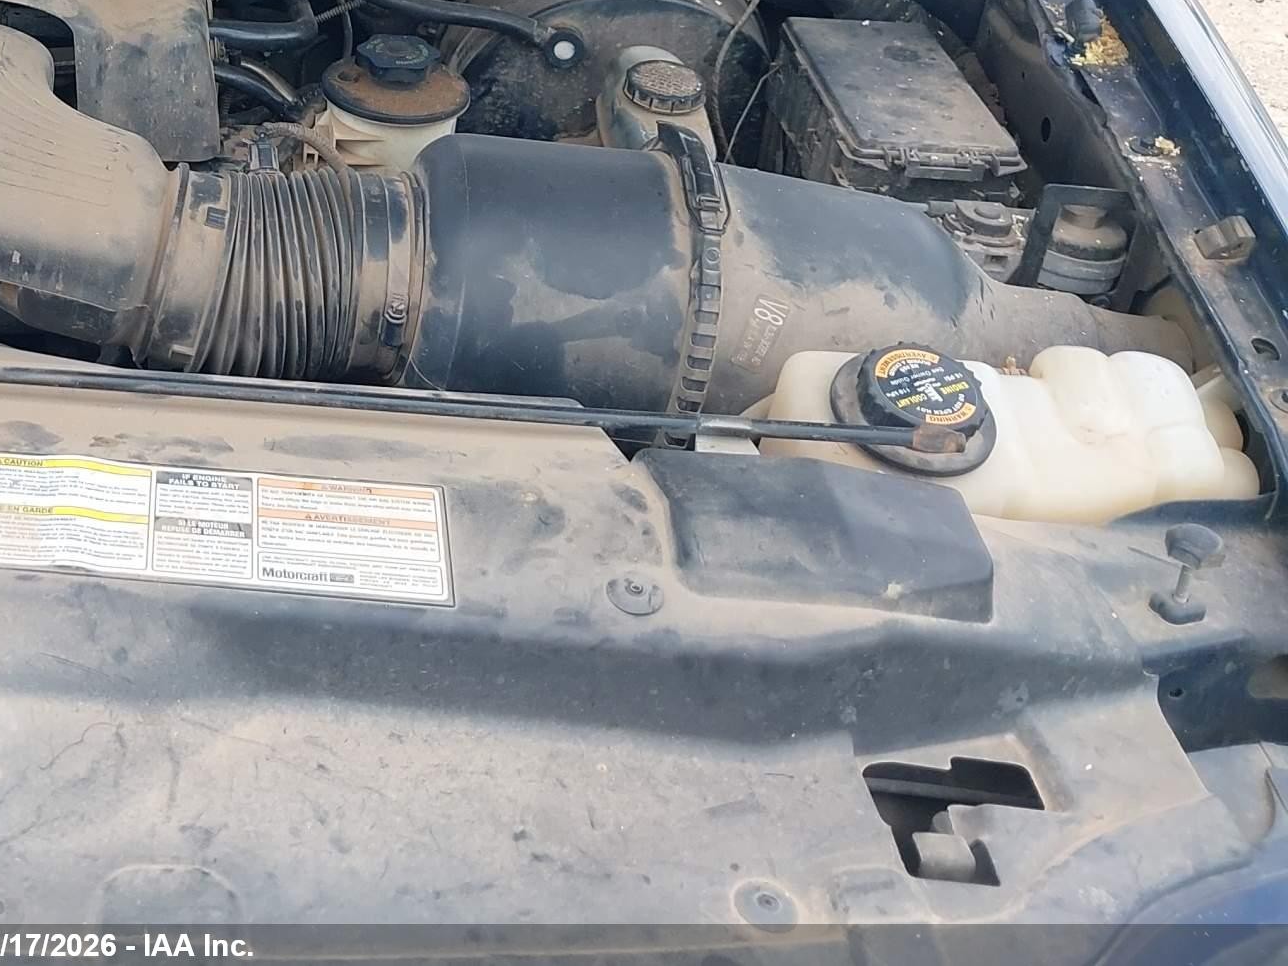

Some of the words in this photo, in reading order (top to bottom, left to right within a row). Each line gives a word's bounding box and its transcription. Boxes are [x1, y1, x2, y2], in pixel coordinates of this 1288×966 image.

[753, 298, 789, 326] V8
[939, 381, 969, 395] ENGINE
[896, 393, 928, 409] COOLANT
[3, 458, 44, 467] CAUTION
[168, 478, 195, 486] FAILS
[211, 481, 240, 490] START
[192, 474, 227, 483] ENGINE
[261, 567, 328, 583] Motorcraft
